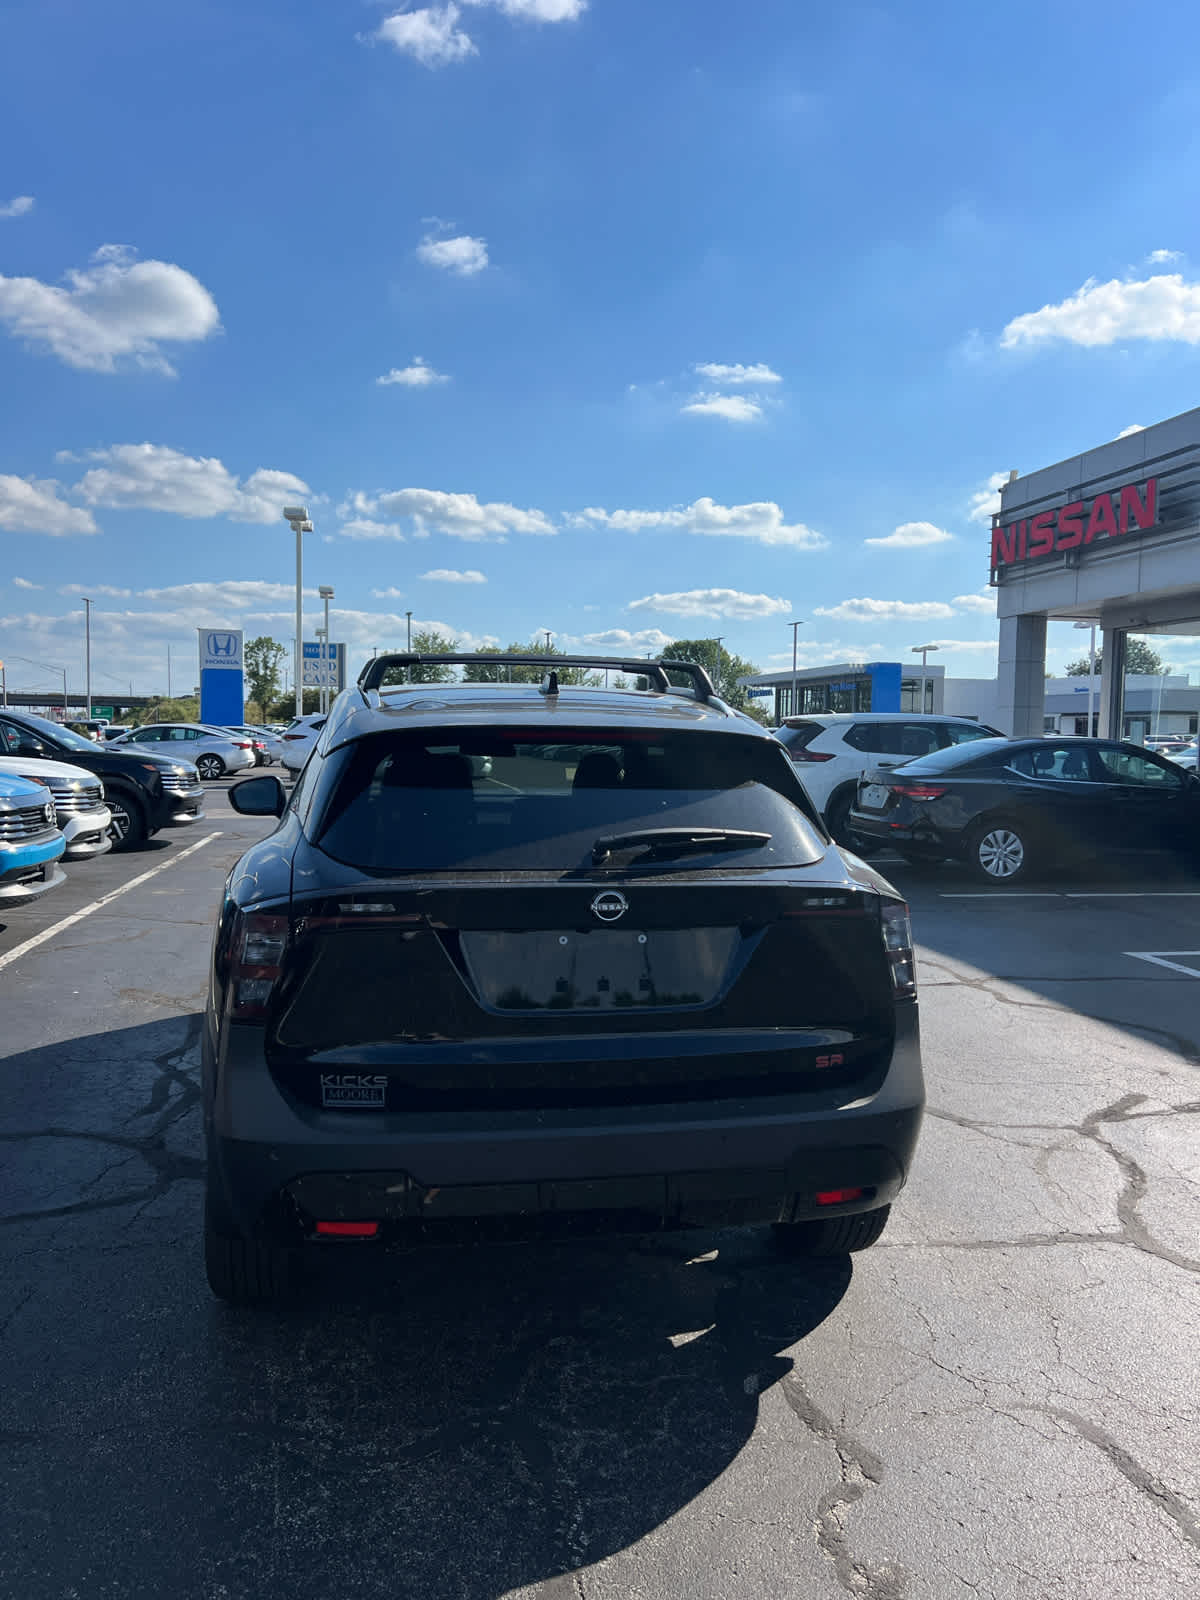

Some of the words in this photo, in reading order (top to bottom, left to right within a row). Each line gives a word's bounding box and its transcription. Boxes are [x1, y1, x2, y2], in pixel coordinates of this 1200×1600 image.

[991, 478, 1157, 568] NISSAN
[591, 903, 629, 911] NISSAN
[815, 1054, 844, 1068] SR
[320, 1074, 389, 1088] KICKS
